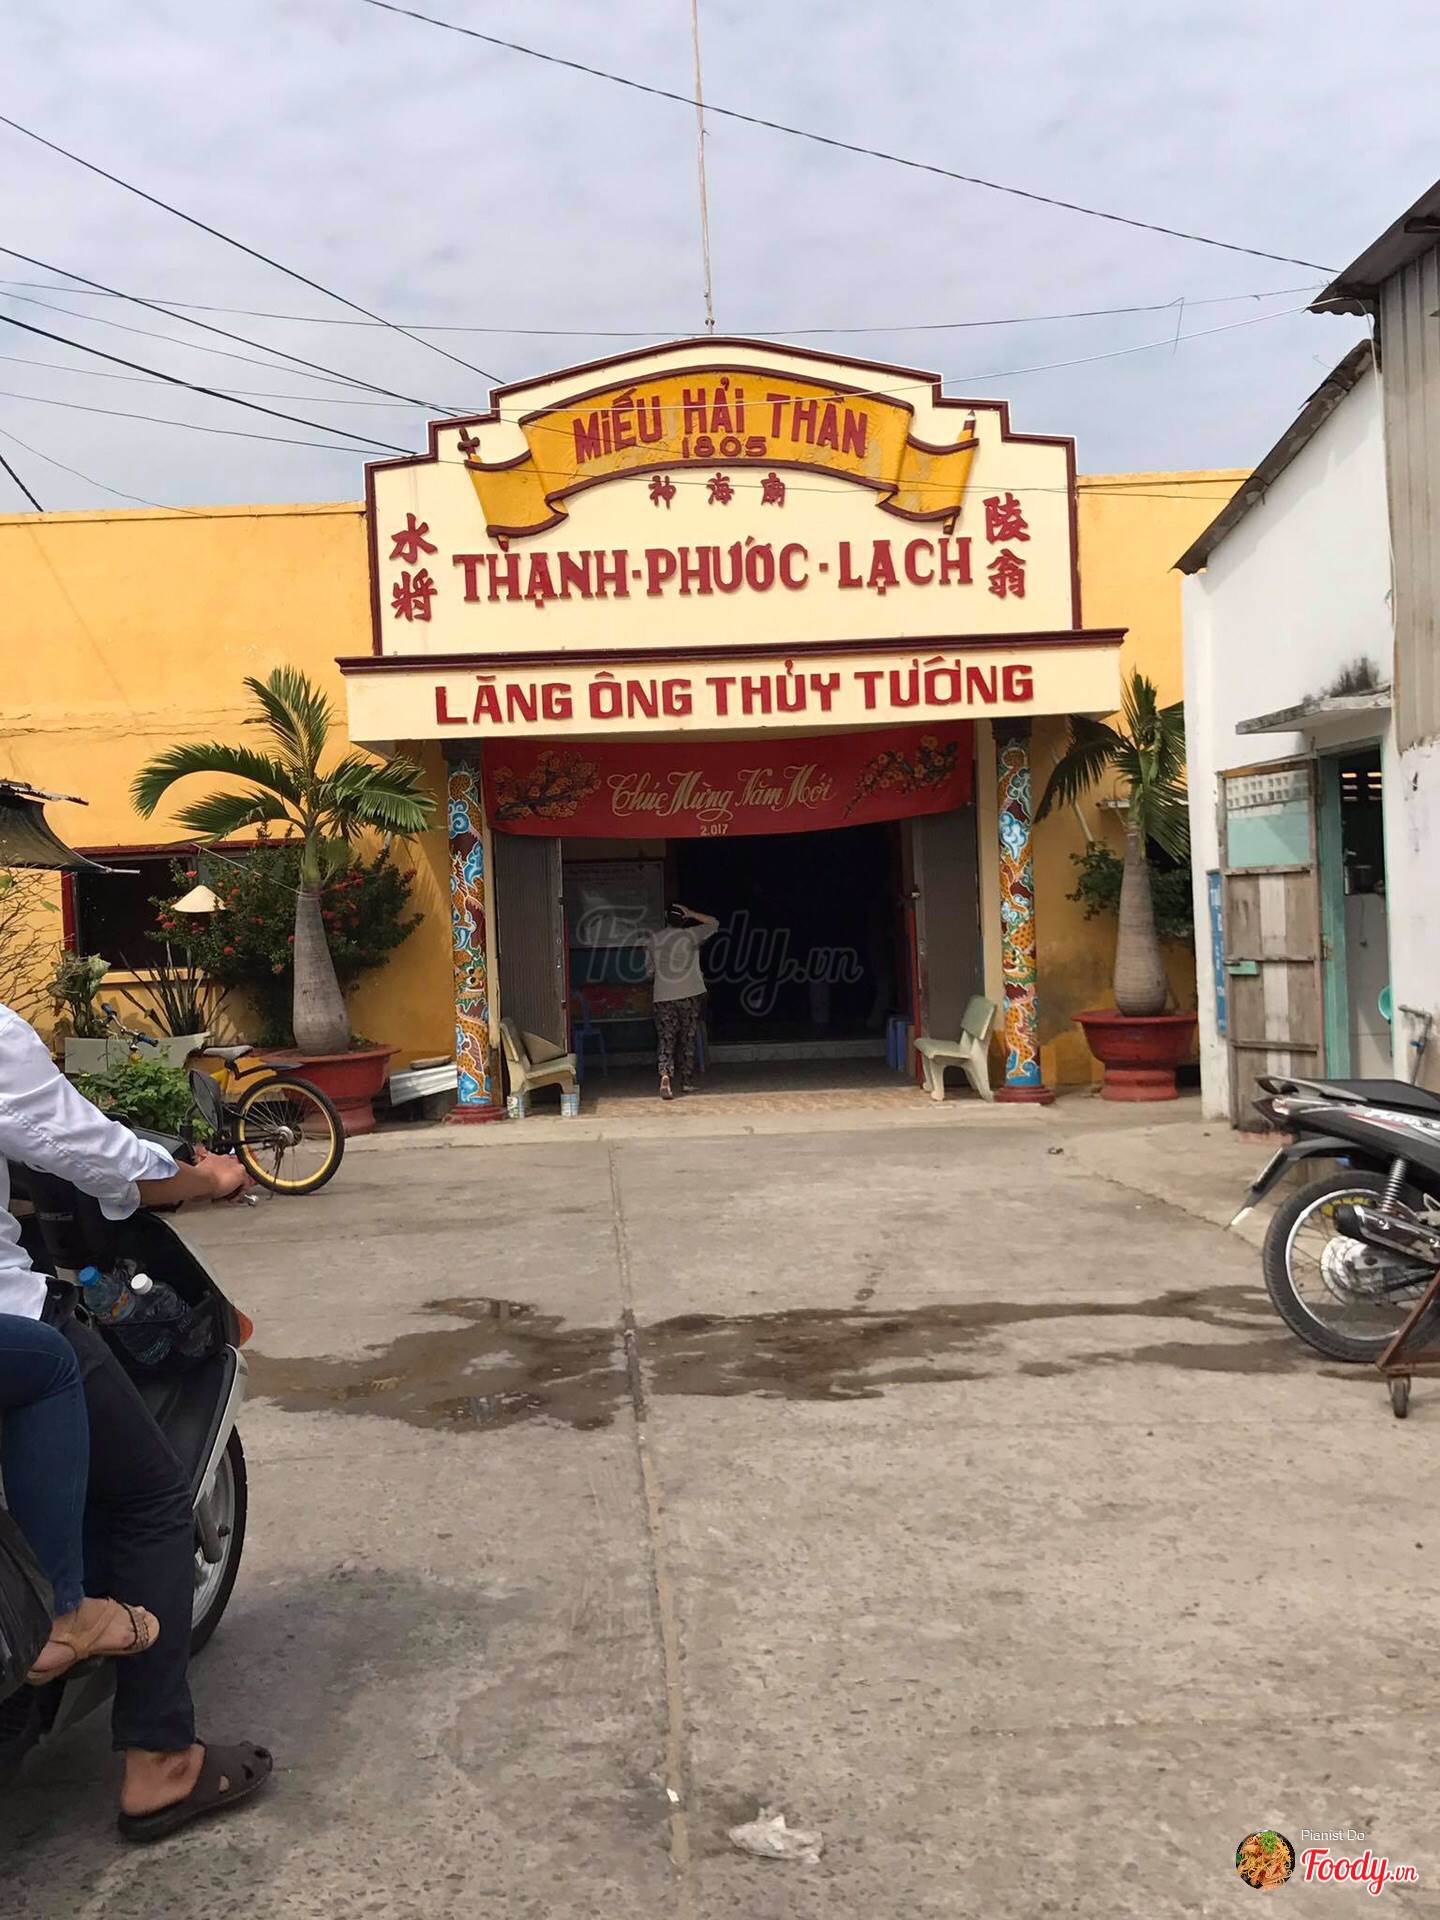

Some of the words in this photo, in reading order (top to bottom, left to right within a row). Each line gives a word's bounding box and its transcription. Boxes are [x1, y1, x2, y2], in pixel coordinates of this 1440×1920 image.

[682, 435, 767, 458] 1805
[435, 675, 573, 725] LĂNG
[589, 671, 693, 719] ÔNG
[706, 658, 840, 715] THỦY
[854, 655, 1034, 709] TƯỚNG
[607, 772, 669, 817] Chúc
